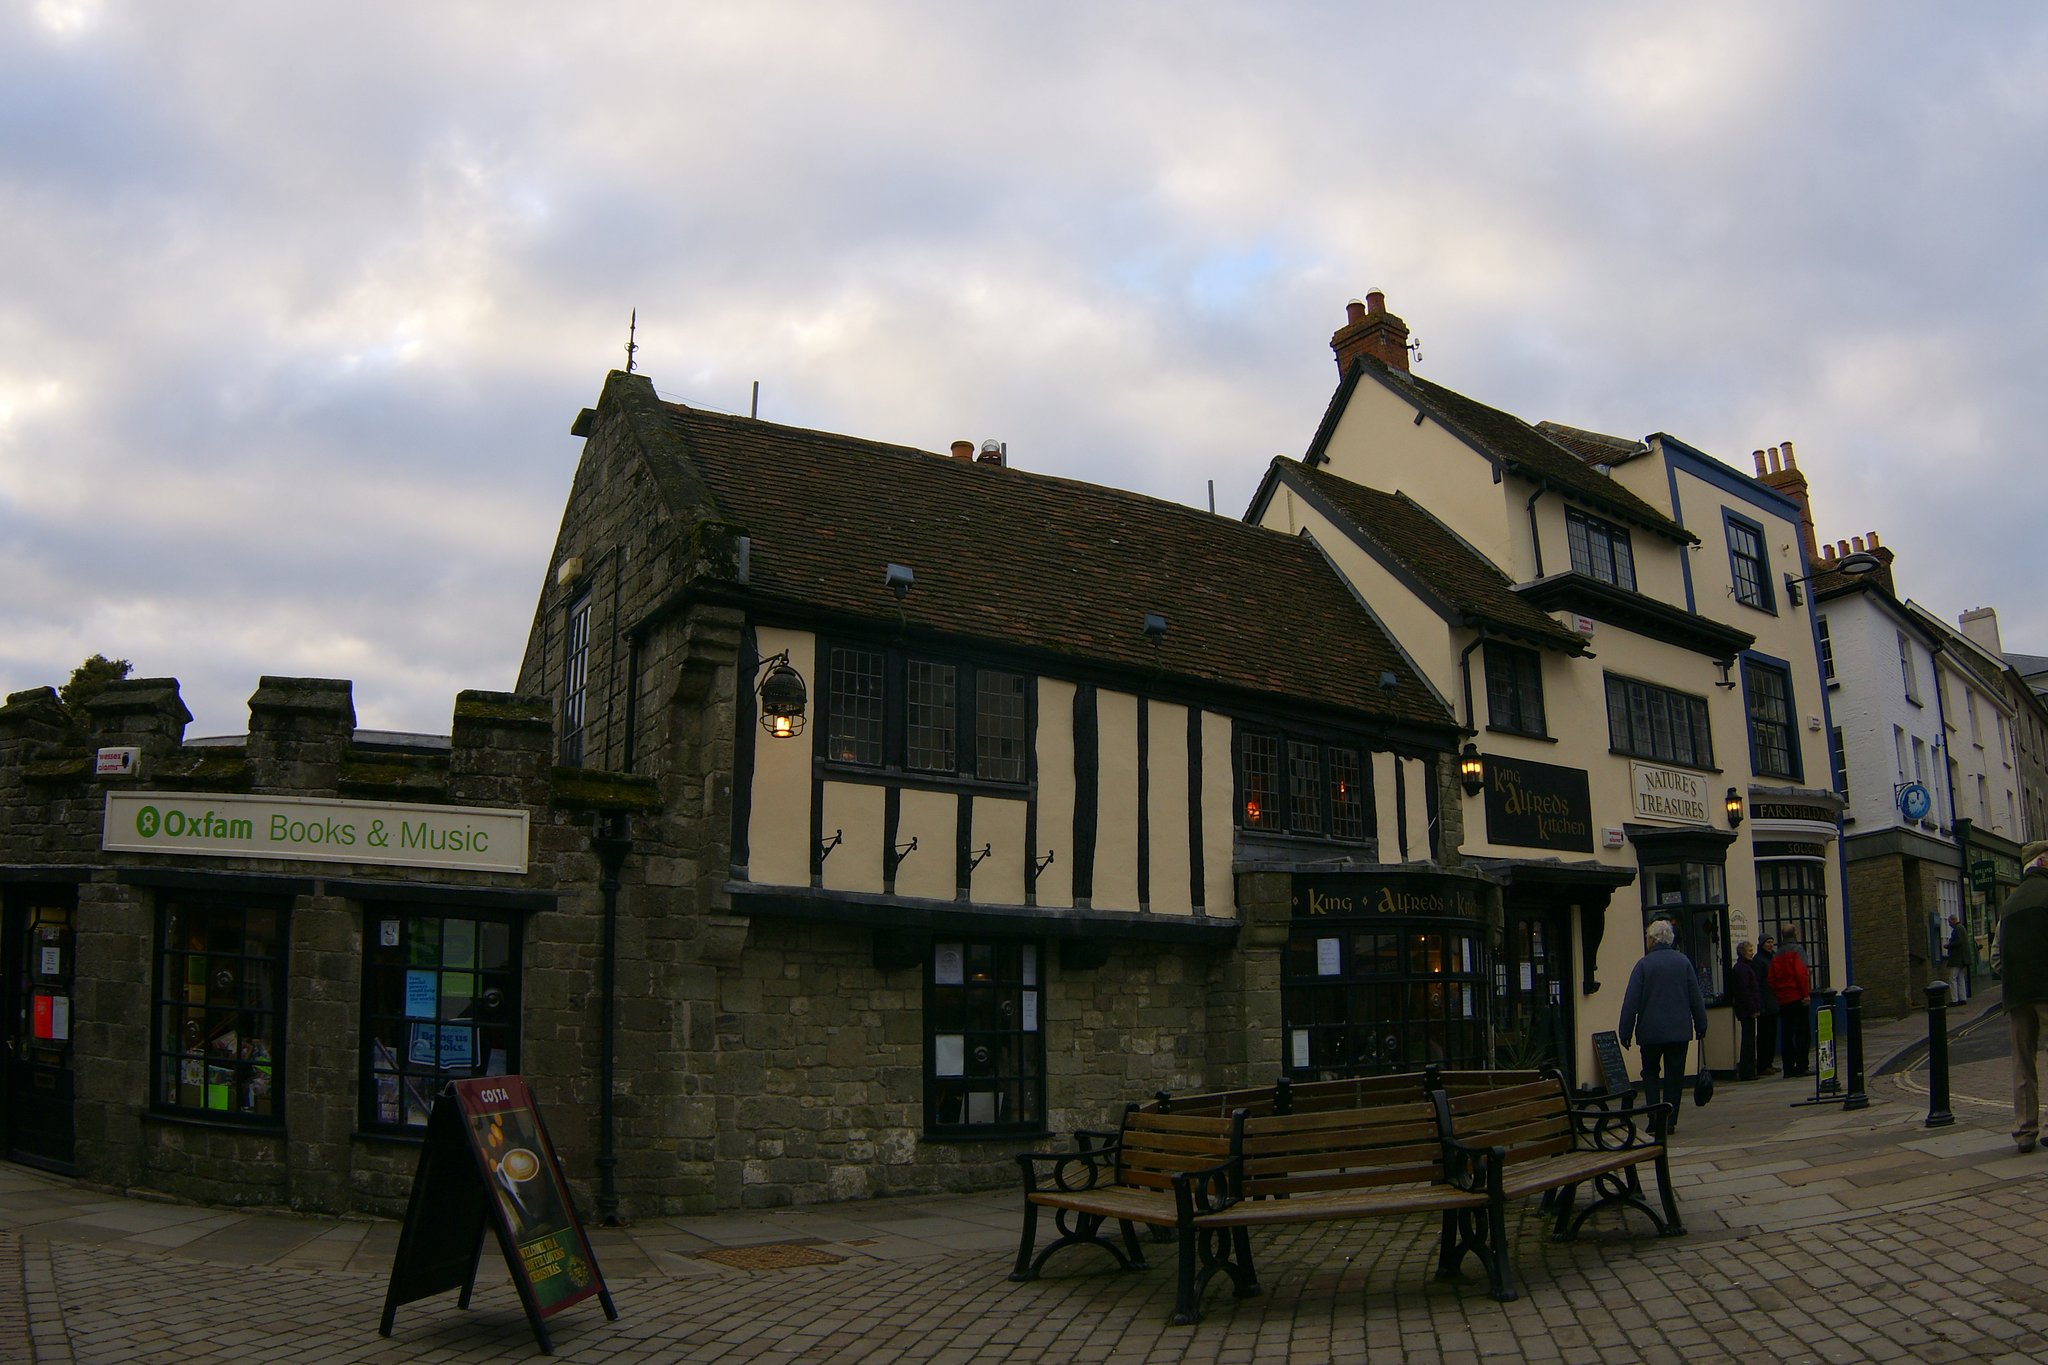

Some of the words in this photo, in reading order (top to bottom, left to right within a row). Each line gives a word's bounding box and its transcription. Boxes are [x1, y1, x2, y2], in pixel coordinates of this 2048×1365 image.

[1645, 771, 1697, 798] NATURE'S
[1639, 792, 1705, 819] TREASURES
[164, 809, 253, 840] Oxfam
[269, 814, 356, 845] Books
[366, 819, 390, 848] &
[401, 821, 489, 852] Music
[1307, 887, 1353, 915] King
[1377, 886, 1445, 914] Alfreds
[481, 1088, 510, 1103] COSTA
